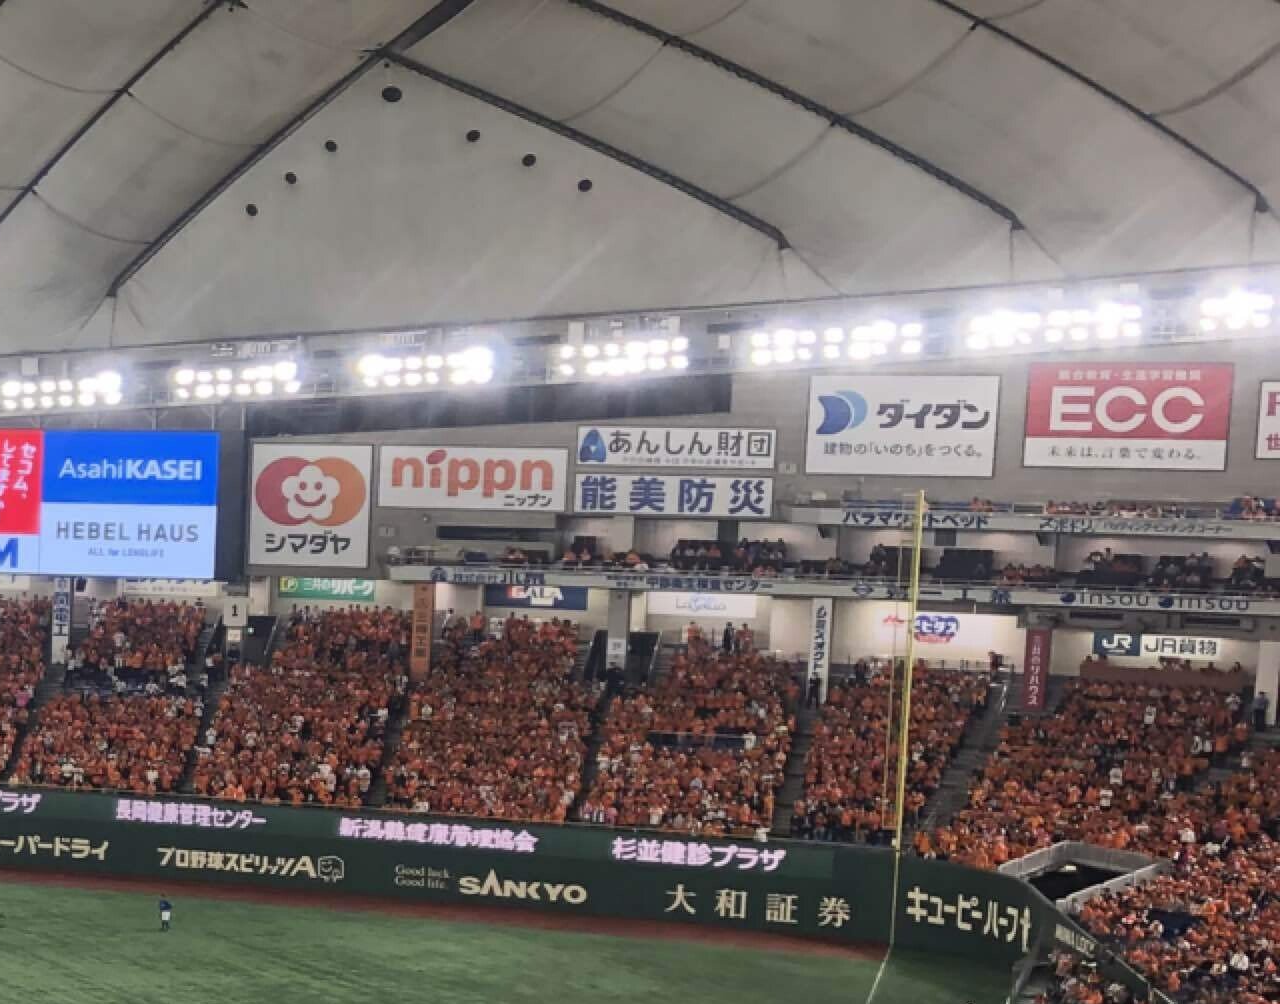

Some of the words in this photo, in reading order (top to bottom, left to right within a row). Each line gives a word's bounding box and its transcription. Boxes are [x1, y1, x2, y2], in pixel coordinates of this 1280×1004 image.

[877, 400, 990, 430] ダイダン
[1050, 385, 1206, 433] ECC
[609, 430, 773, 457] あんしん財団
[391, 450, 554, 496] nippn
[503, 493, 553, 508] ニップン
[580, 476, 765, 515] 能美防災
[56, 520, 130, 541] HEBEL
[137, 523, 200, 543] HAUS
[842, 510, 989, 529] パラマウトベッド
[264, 532, 351, 555] シマダヤ
[1102, 632, 1132, 649] JR
[157, 847, 317, 879] プロ野球スピリッツA
[611, 836, 786, 871] 杉並健診プラザ
[458, 868, 588, 904] SANKYO
[664, 883, 851, 928] 大和証券
